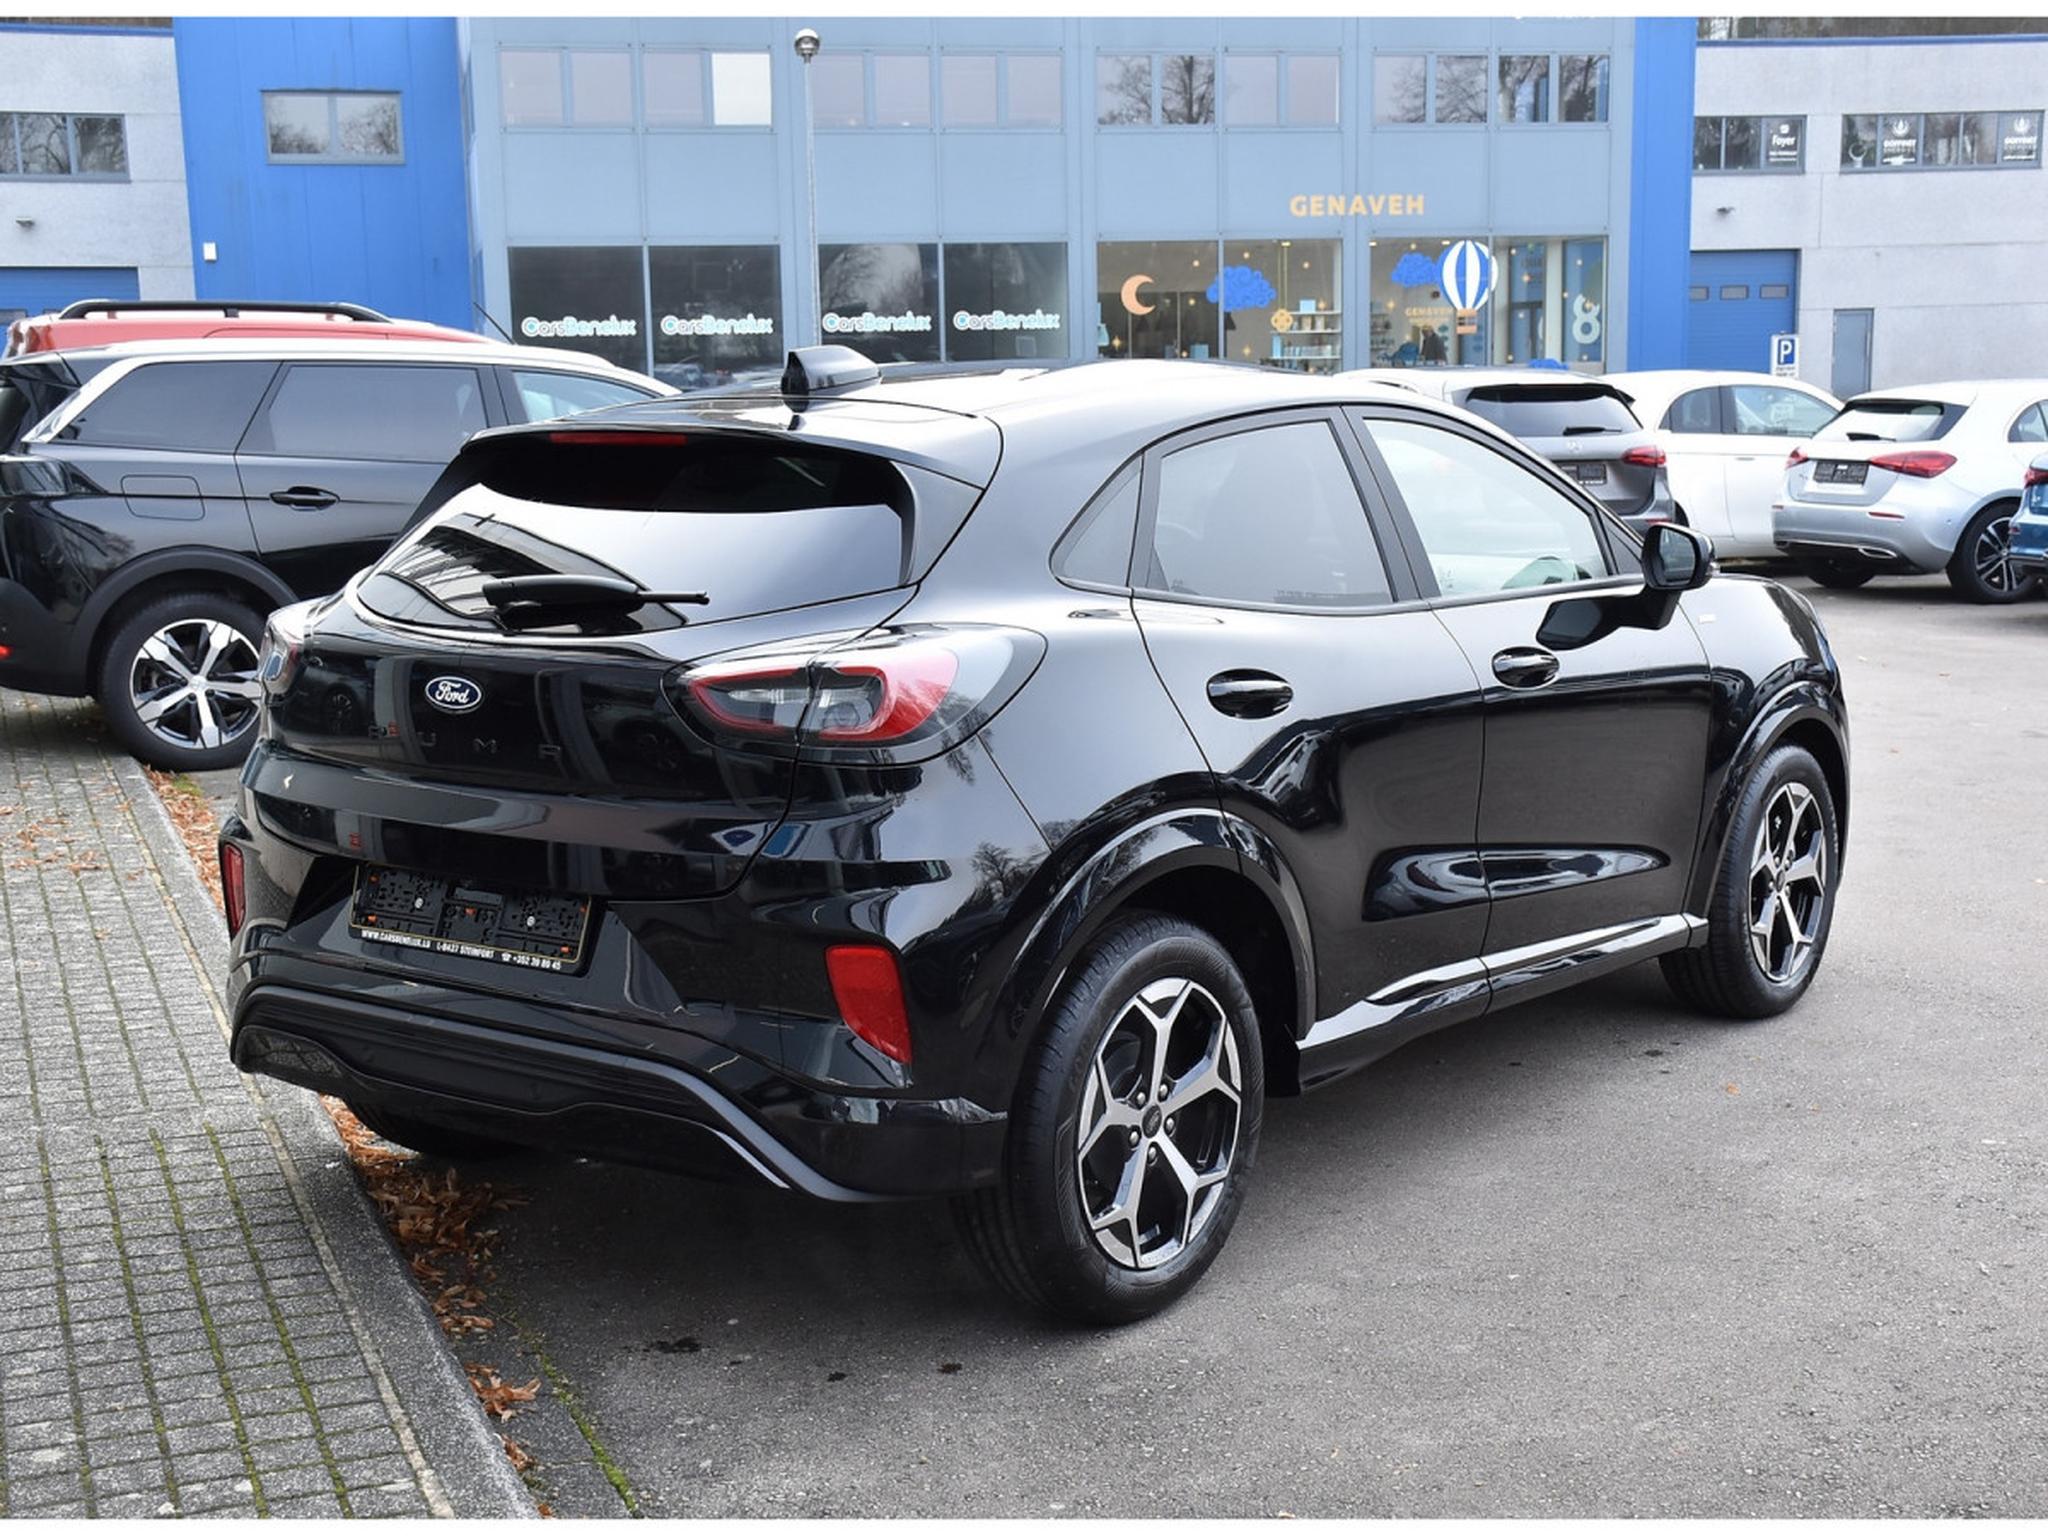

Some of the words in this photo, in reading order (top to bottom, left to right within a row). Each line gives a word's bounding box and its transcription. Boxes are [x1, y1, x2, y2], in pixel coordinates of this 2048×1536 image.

[1772, 134, 1796, 148] Foyer
[1289, 194, 1425, 217] GENAVEH
[521, 314, 638, 338] CarsBenelux
[660, 312, 774, 336] CarsBenelux
[822, 310, 932, 333] CarsBenelux
[953, 308, 1061, 331] CarsBenelux
[1780, 340, 1793, 364] P
[435, 680, 471, 704] Ford
